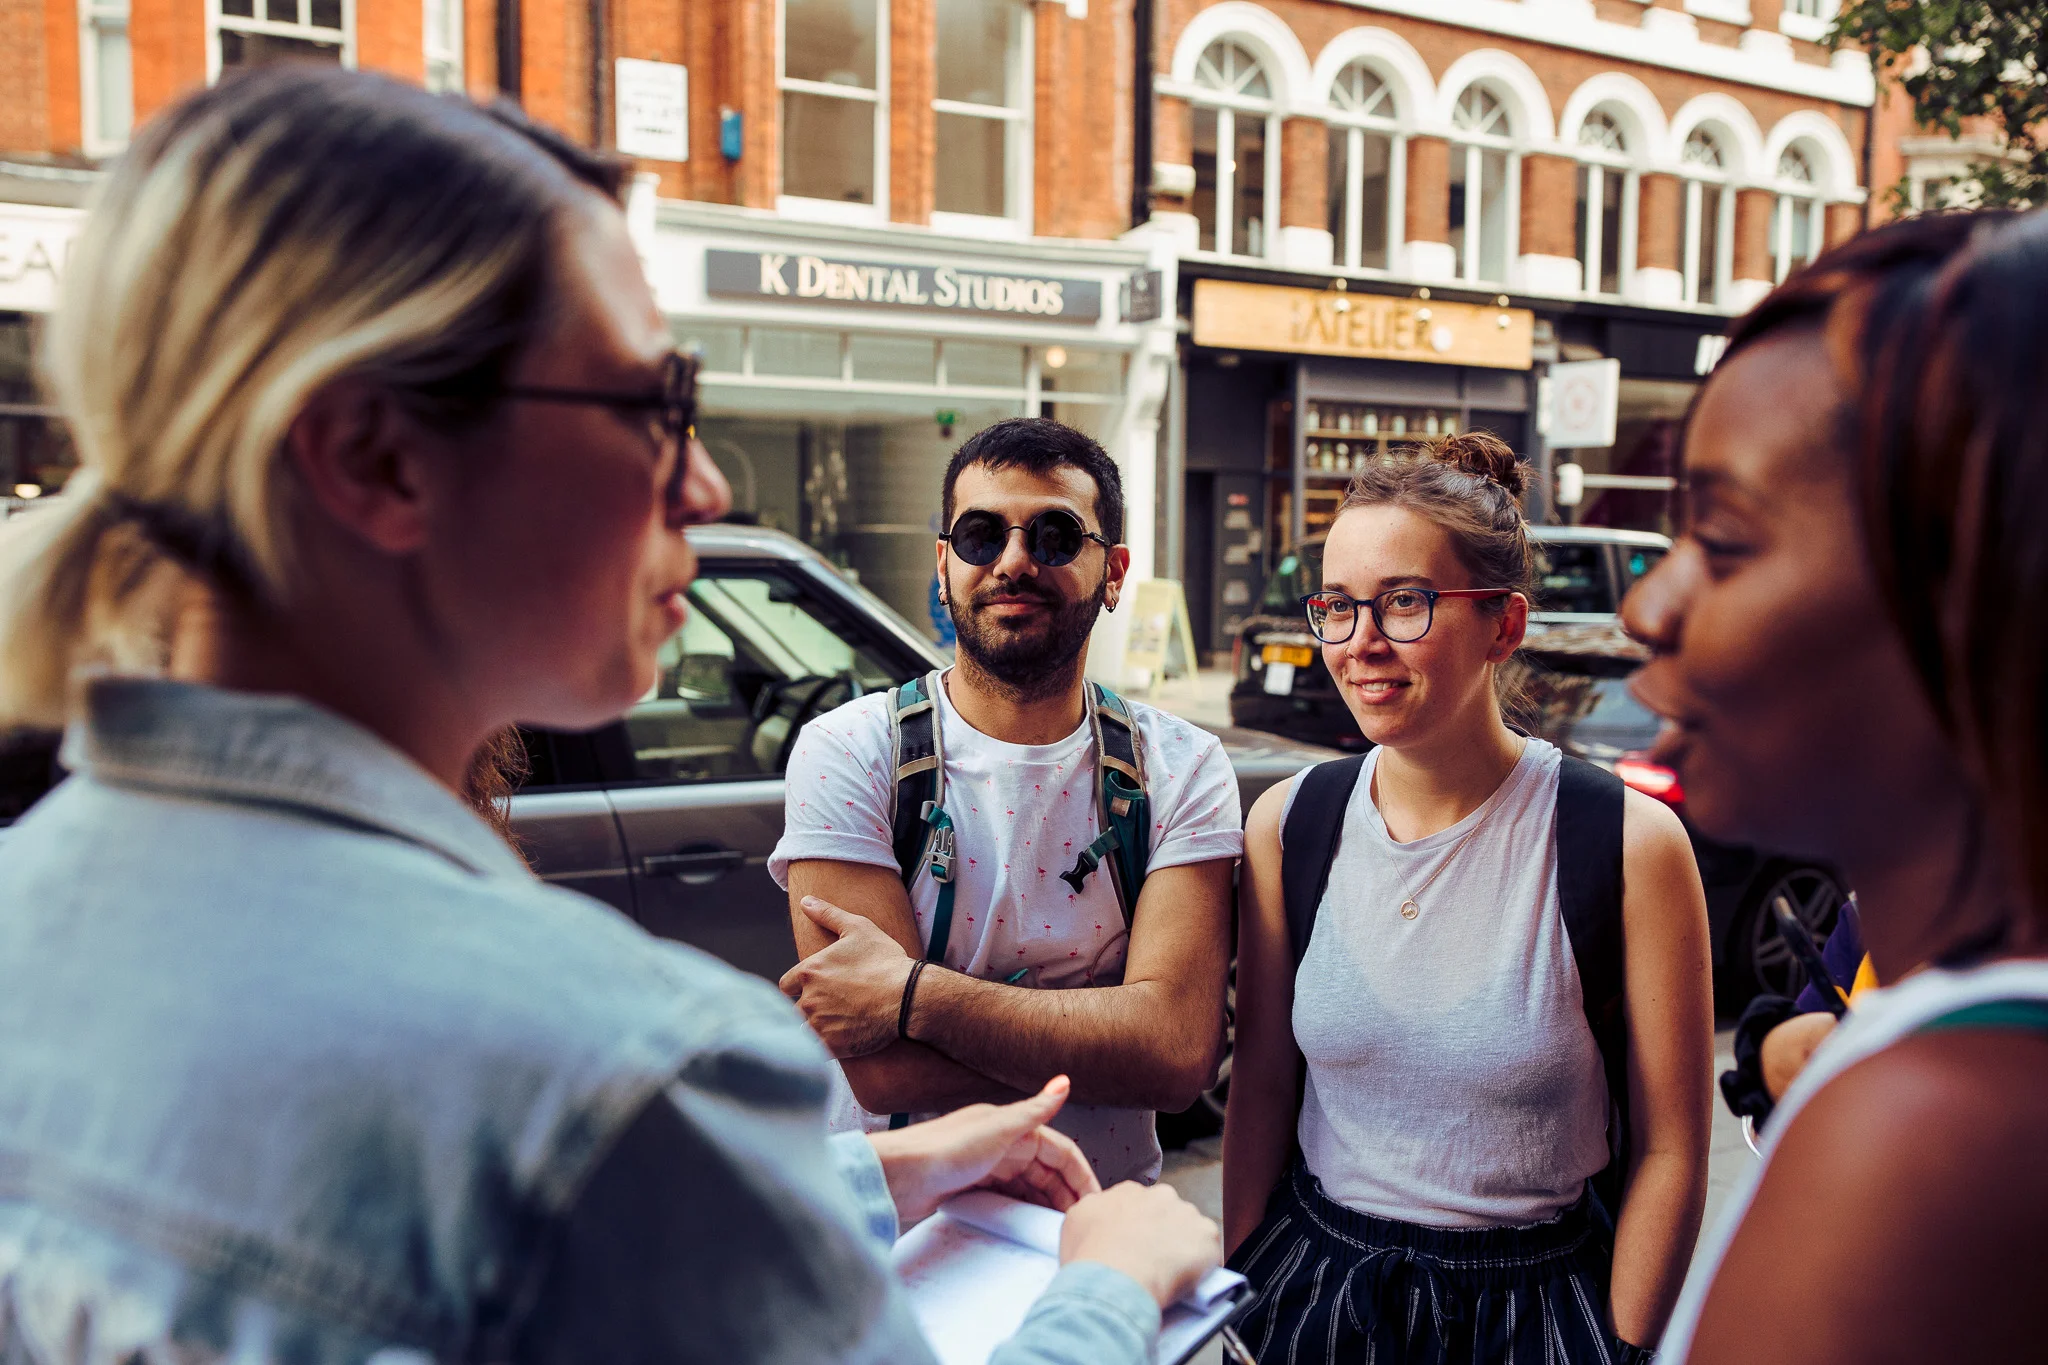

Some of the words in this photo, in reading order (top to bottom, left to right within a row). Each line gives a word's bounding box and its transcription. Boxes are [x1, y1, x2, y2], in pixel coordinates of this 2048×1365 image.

[760, 252, 790, 296] K
[796, 255, 929, 305] DENTAL
[933, 267, 1064, 316] STUDIOS
